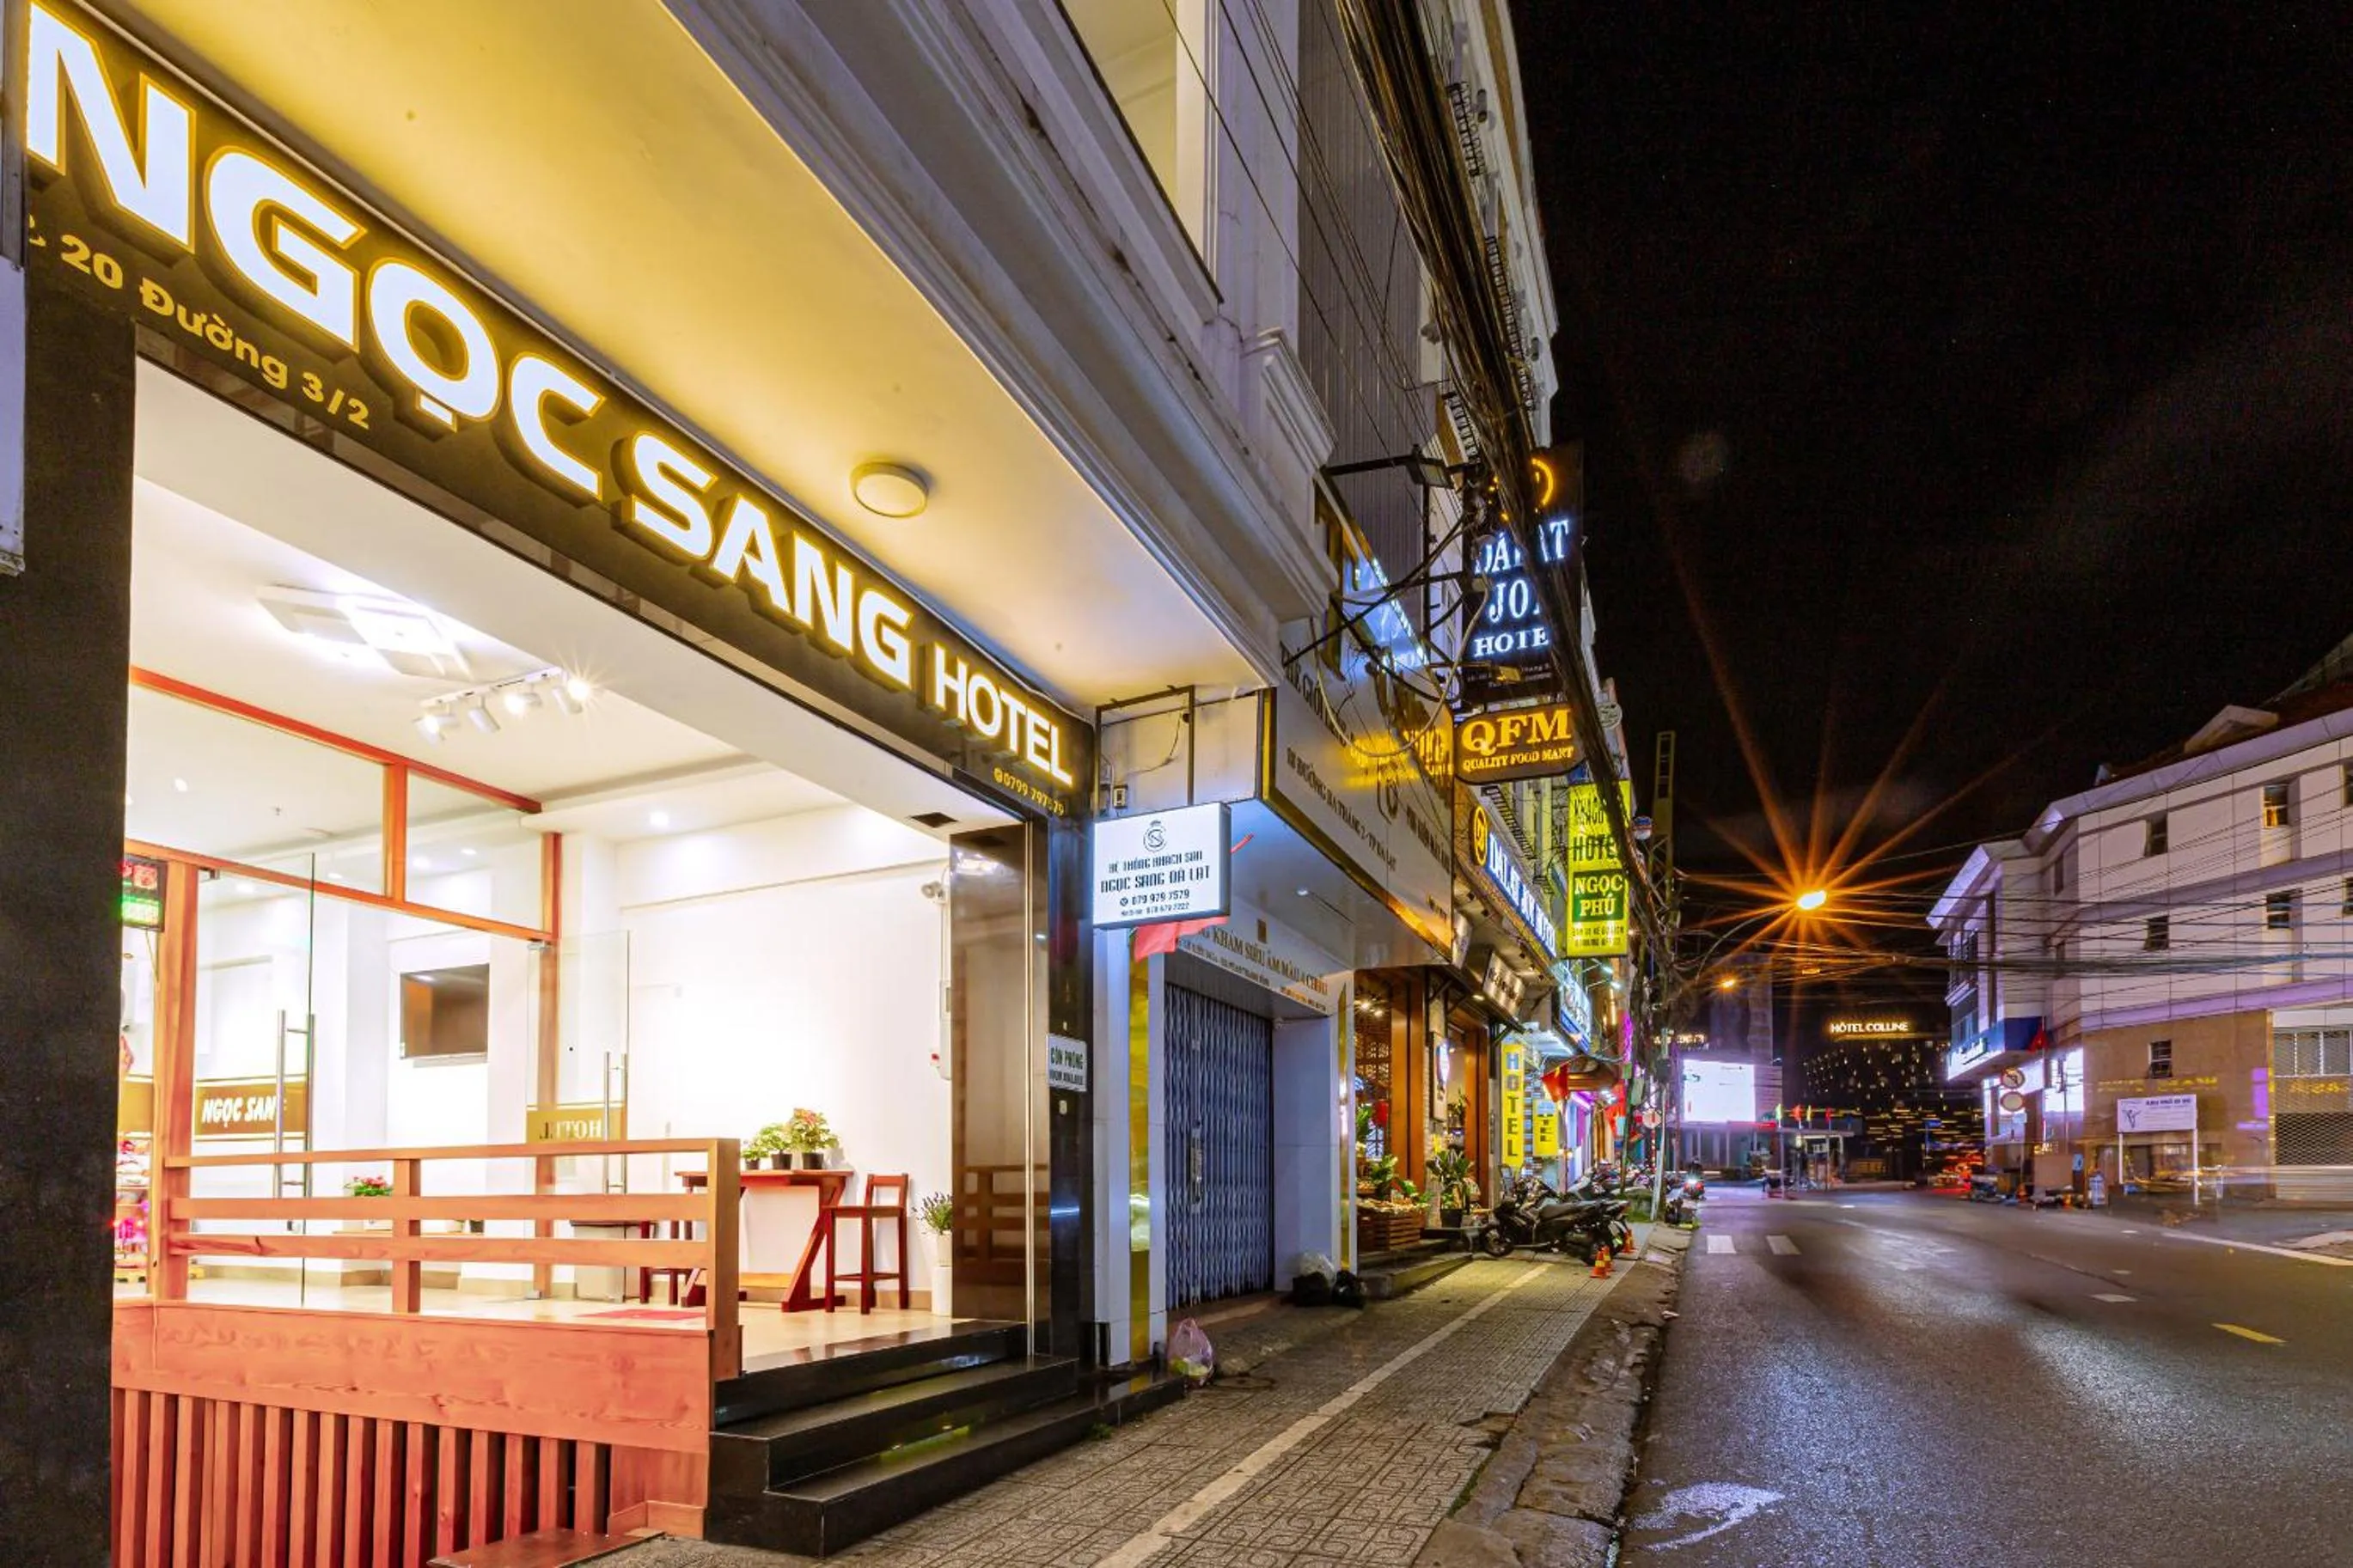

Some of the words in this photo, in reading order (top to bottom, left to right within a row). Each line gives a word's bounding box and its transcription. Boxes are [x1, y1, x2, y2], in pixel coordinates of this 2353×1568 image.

[60, 235, 123, 289] 20
[139, 277, 288, 389] Đường
[302, 372, 370, 430] 3/2
[26, 2, 605, 502] NGỌC
[628, 431, 914, 688] SANG
[933, 646, 1073, 787] HOTEL
[1488, 579, 1541, 623] JO
[1474, 627, 1549, 657] HOTE
[1462, 709, 1572, 756] QFM
[1463, 755, 1508, 772] QUALITY
[1510, 752, 1540, 765] FOOD
[1542, 746, 1574, 761] MART
[1004, 772, 1029, 796] 0799
[1573, 834, 1618, 862] HOTE
[1134, 872, 1165, 888] SANG
[1574, 874, 1623, 895] NGỌC
[1580, 893, 1617, 917] PHÚ
[201, 1096, 244, 1127] NGỌC
[244, 1095, 287, 1122] SAN
[1507, 1052, 1519, 1156] HOTEL
